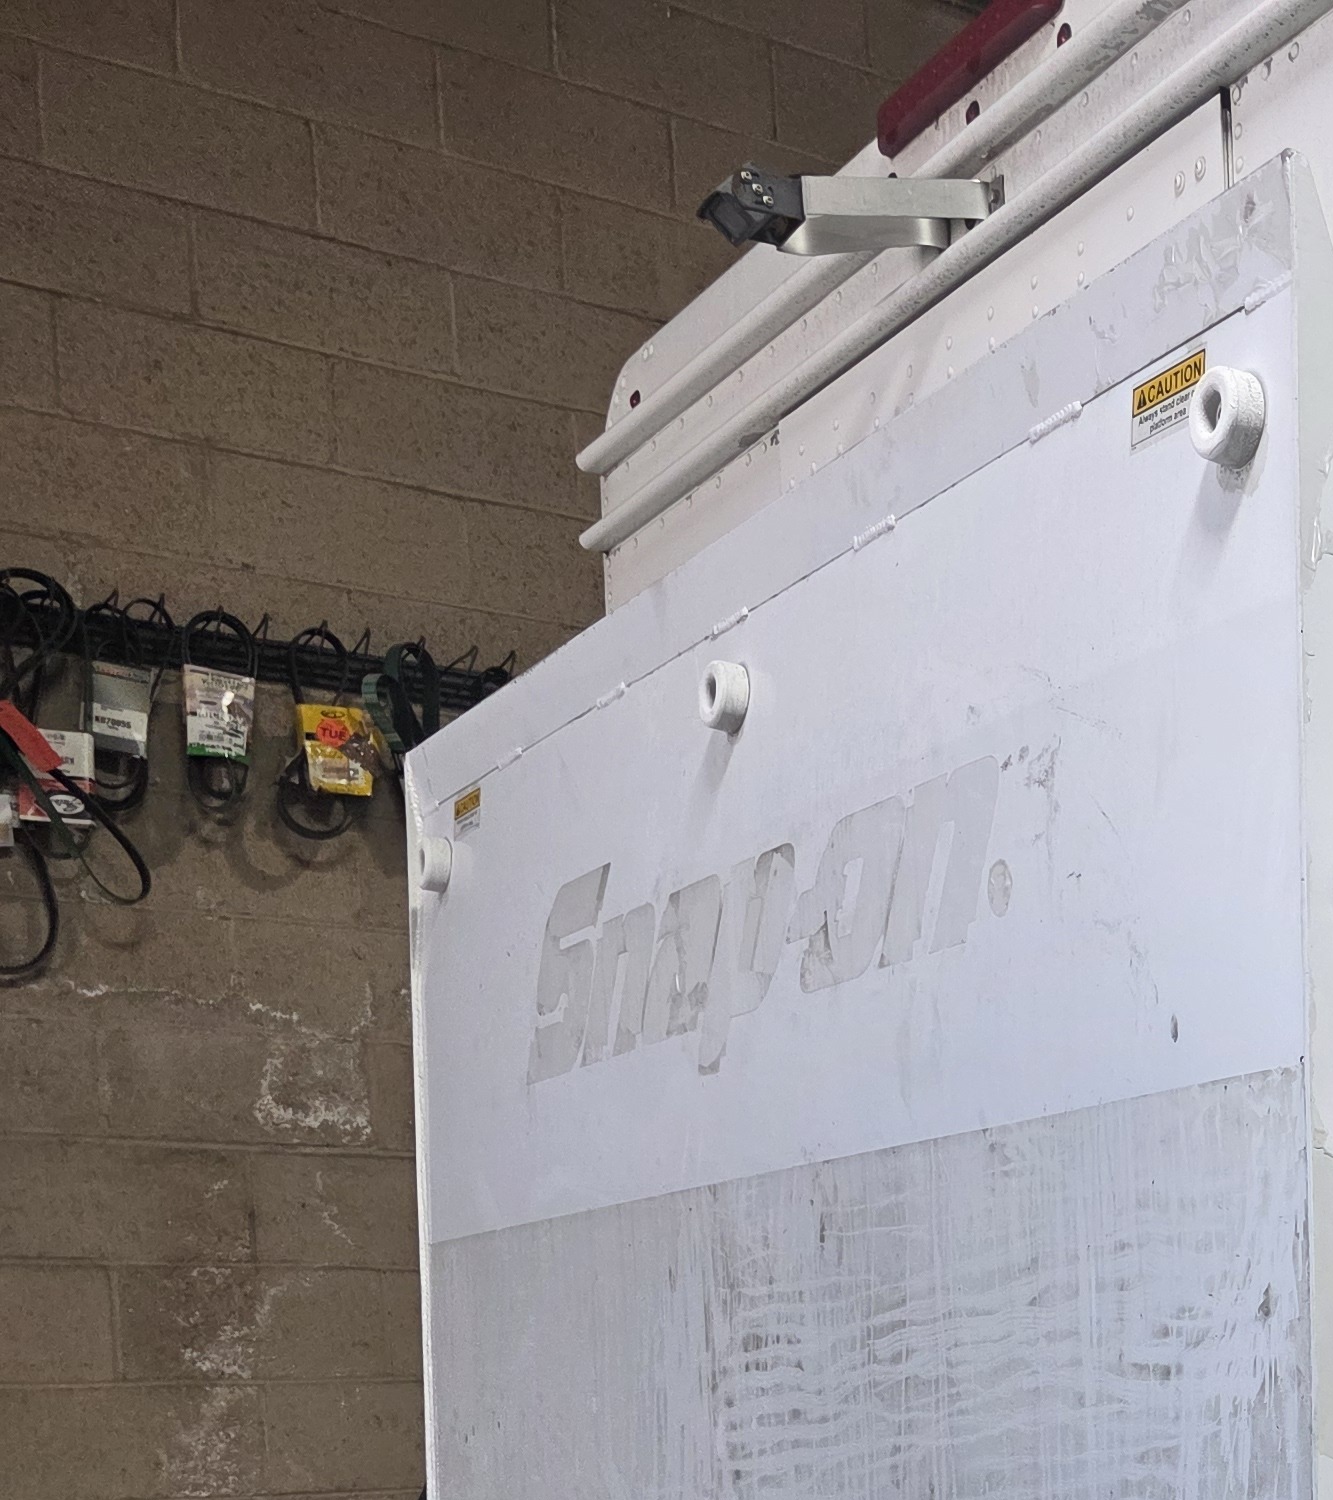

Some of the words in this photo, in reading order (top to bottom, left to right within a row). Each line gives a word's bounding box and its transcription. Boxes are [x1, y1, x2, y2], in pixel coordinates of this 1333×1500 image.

[1148, 358, 1202, 403] CAUTION
[1138, 408, 1159, 426] Always
[1160, 398, 1175, 414] stand
